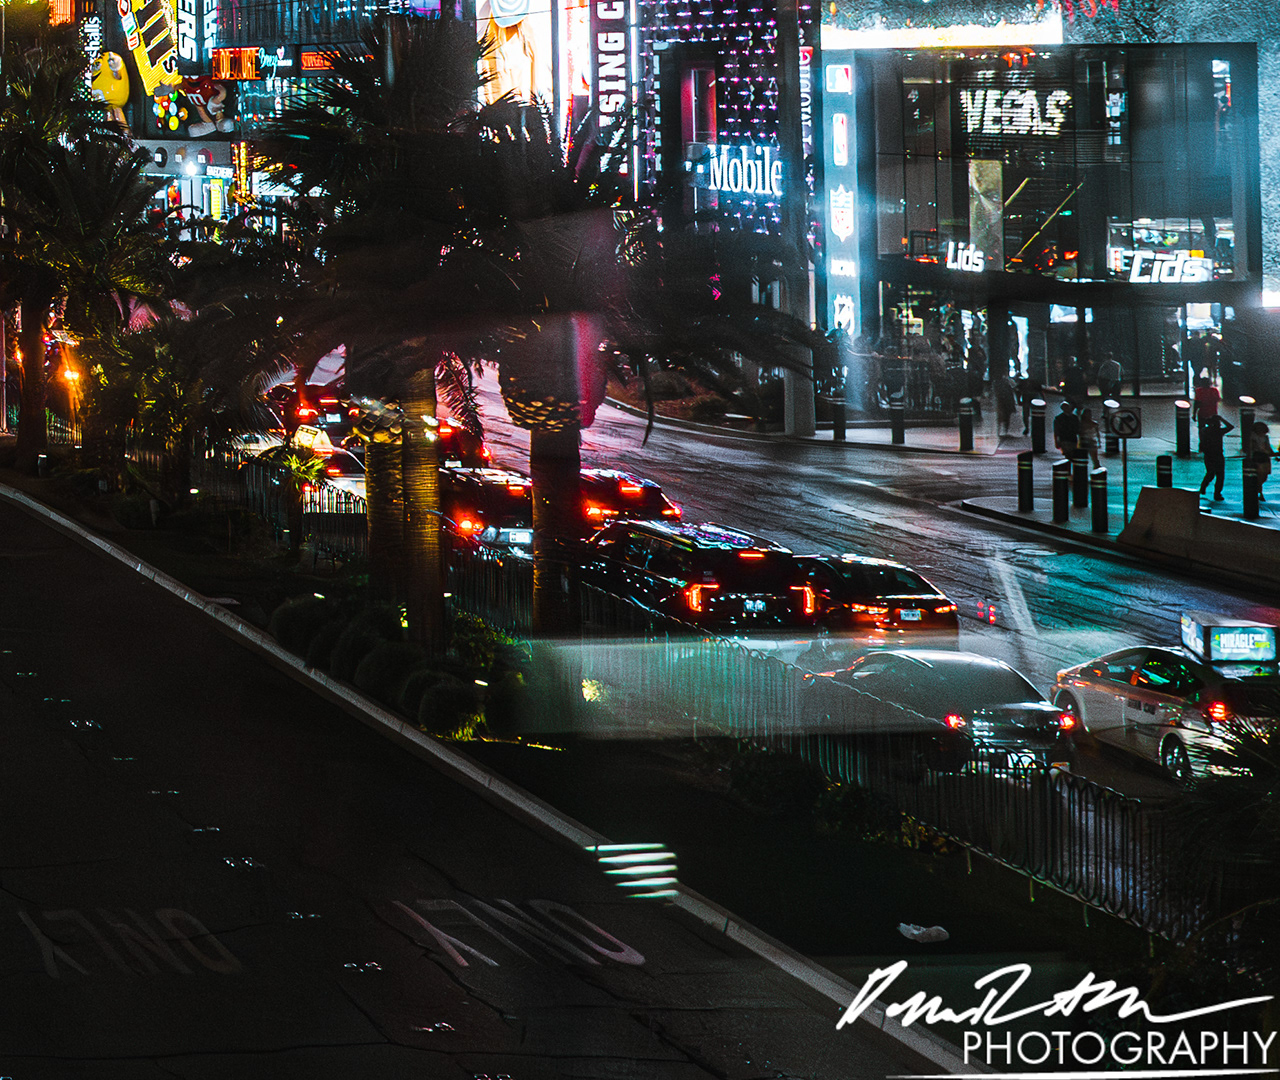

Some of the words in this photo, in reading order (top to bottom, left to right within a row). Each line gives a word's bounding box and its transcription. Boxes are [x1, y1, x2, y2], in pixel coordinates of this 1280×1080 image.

[84, 16, 101, 89] Mrshalls
[598, 32, 628, 173] SING
[959, 89, 1072, 135] VEGAS
[707, 144, 783, 196] Mobile
[946, 242, 985, 273] Lids
[1130, 254, 1202, 283] Lids
